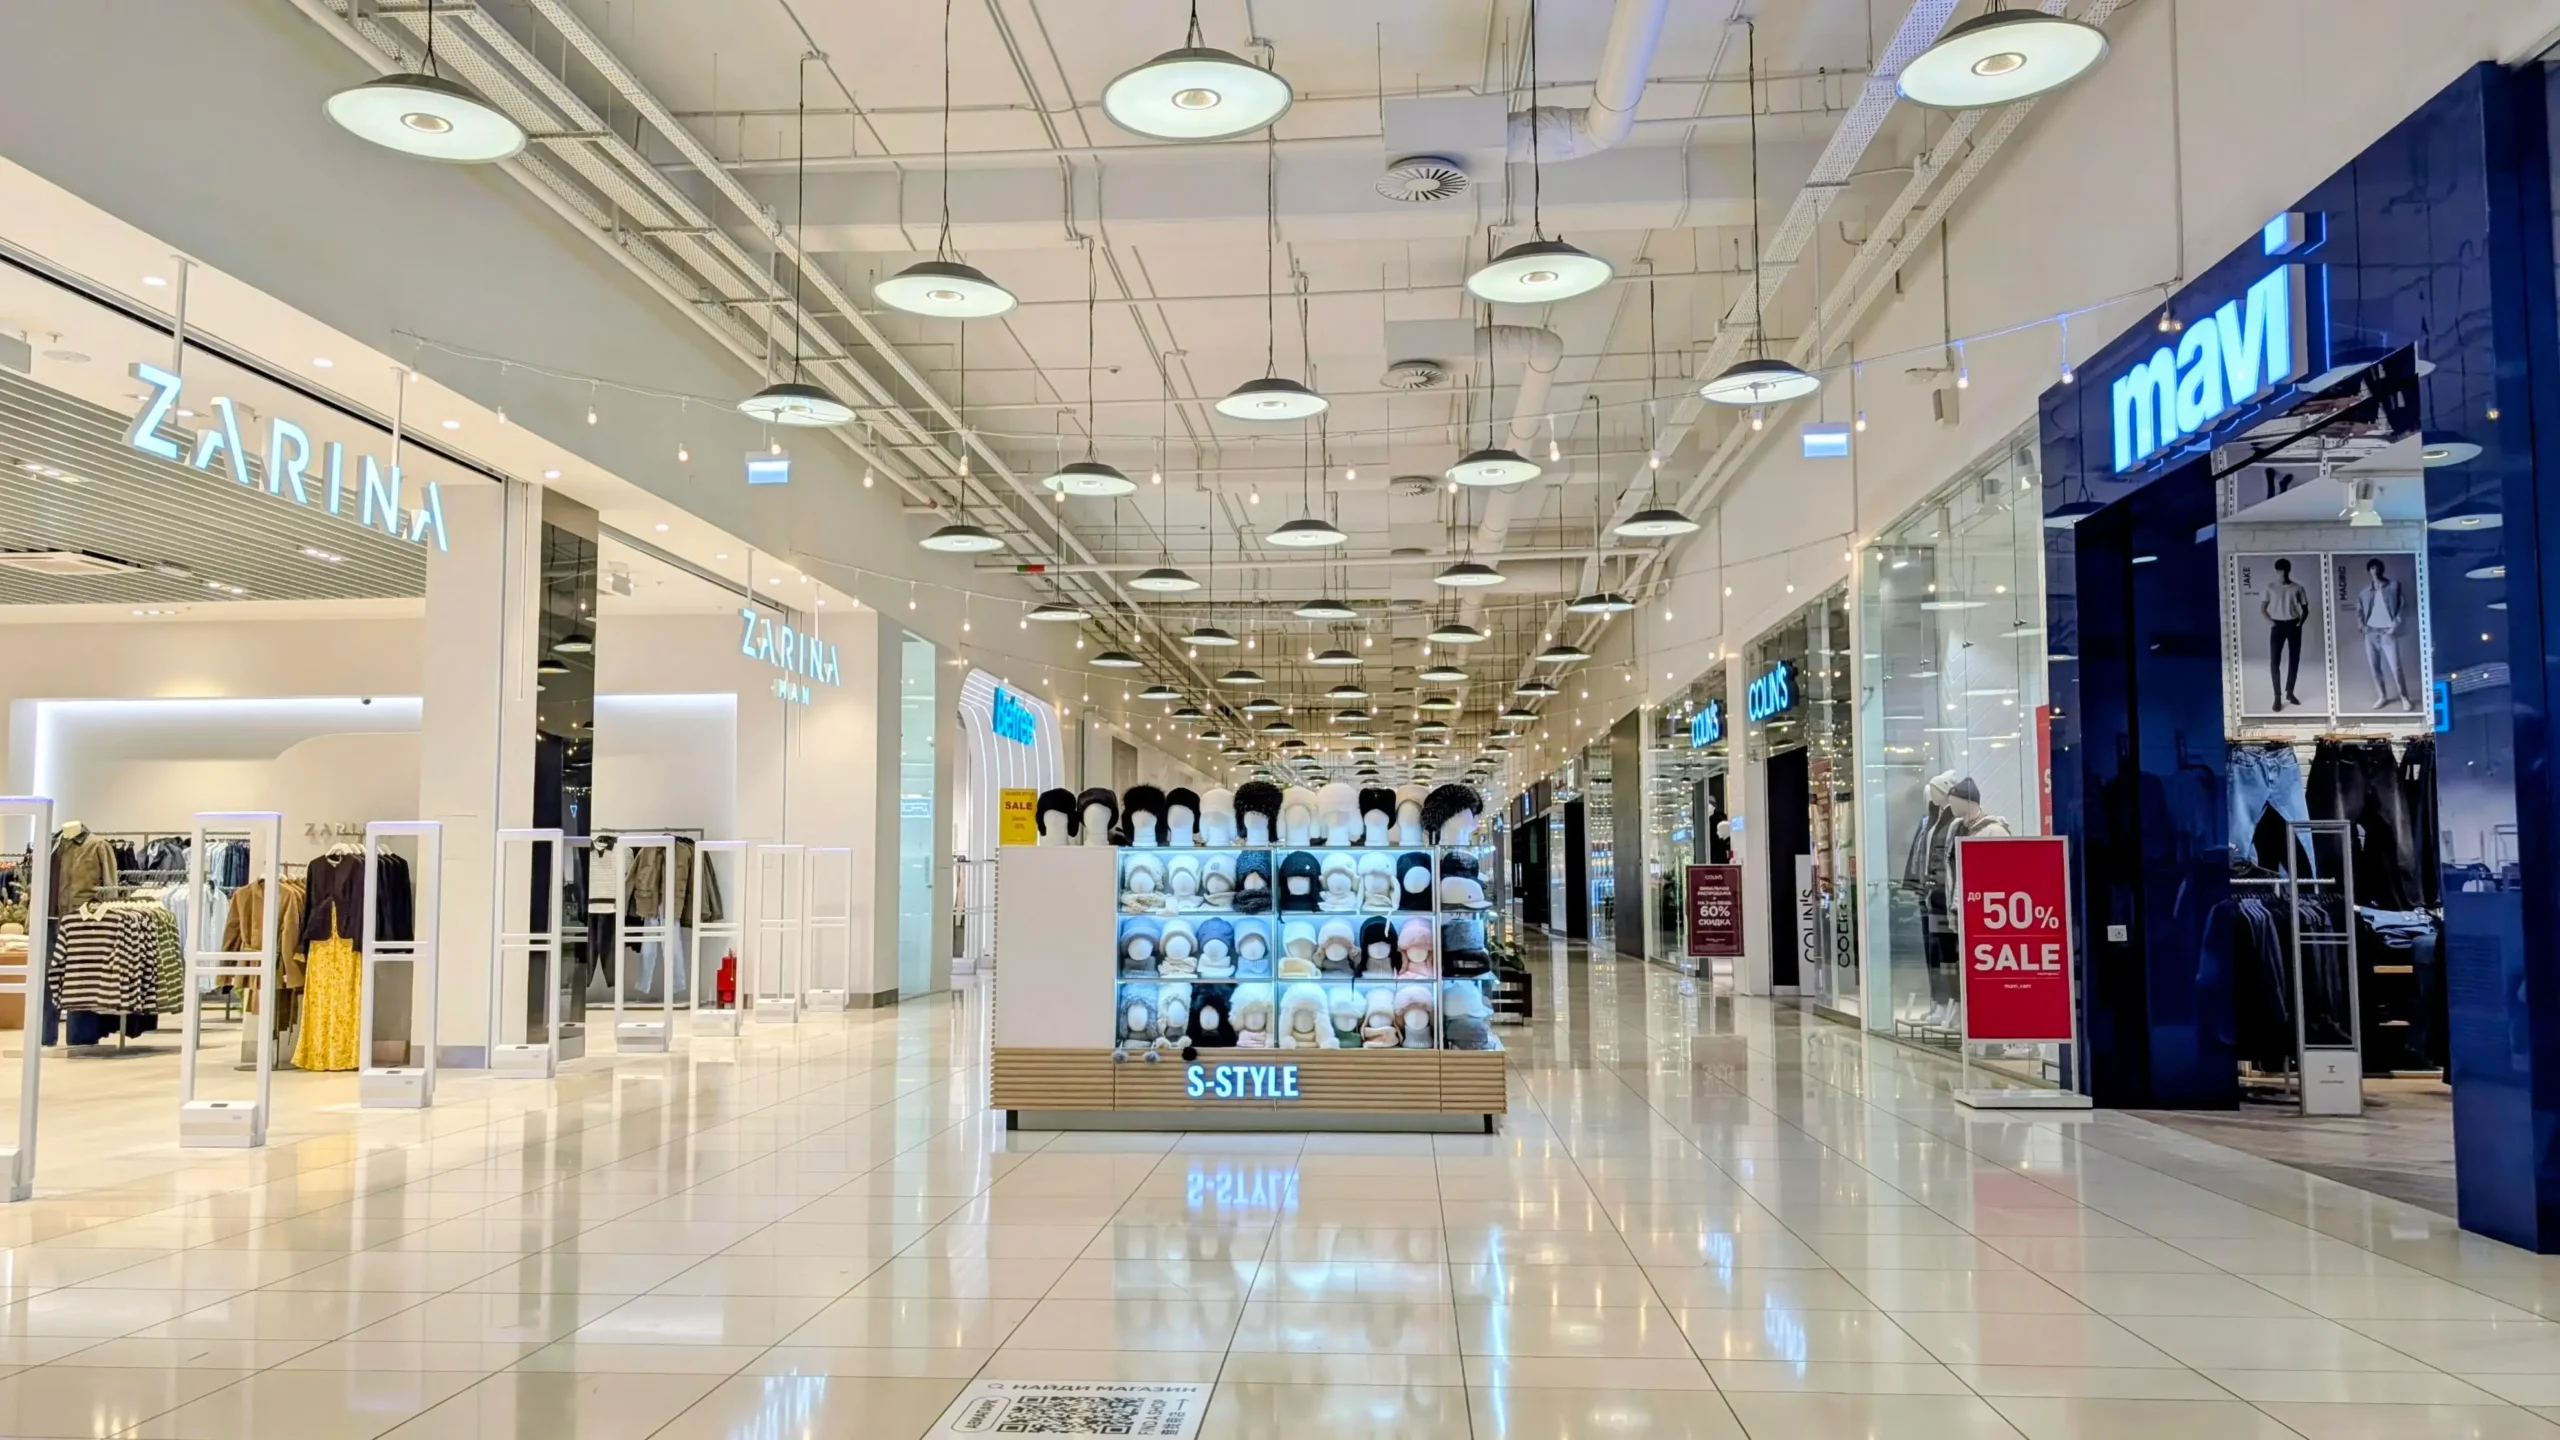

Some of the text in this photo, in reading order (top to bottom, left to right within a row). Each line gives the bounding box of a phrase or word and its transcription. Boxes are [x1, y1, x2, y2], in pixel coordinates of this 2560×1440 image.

[2112, 211, 2296, 475] mavi
[126, 361, 448, 552] ZARINA
[2243, 567, 2251, 588] JAKE
[740, 608, 840, 687] ZARINA
[774, 678, 810, 706] MAN
[1748, 660, 1788, 722] COLIN'S
[993, 685, 1034, 746] Befree
[1692, 699, 1719, 748] COLIN'S
[1005, 801, 1033, 810] SALE
[304, 822, 367, 836] ZARI
[1700, 905, 1731, 917] 60%
[1967, 891, 2059, 930] ДО 50%
[1974, 943, 2061, 971] SALE
[1186, 1064, 1299, 1098] S-STYLE
[1012, 1383, 1198, 1393] НАЙДИ МАГАЗИН
[1147, 1399, 1167, 1416] SHOP
[1137, 1421, 1158, 1435] FIND
